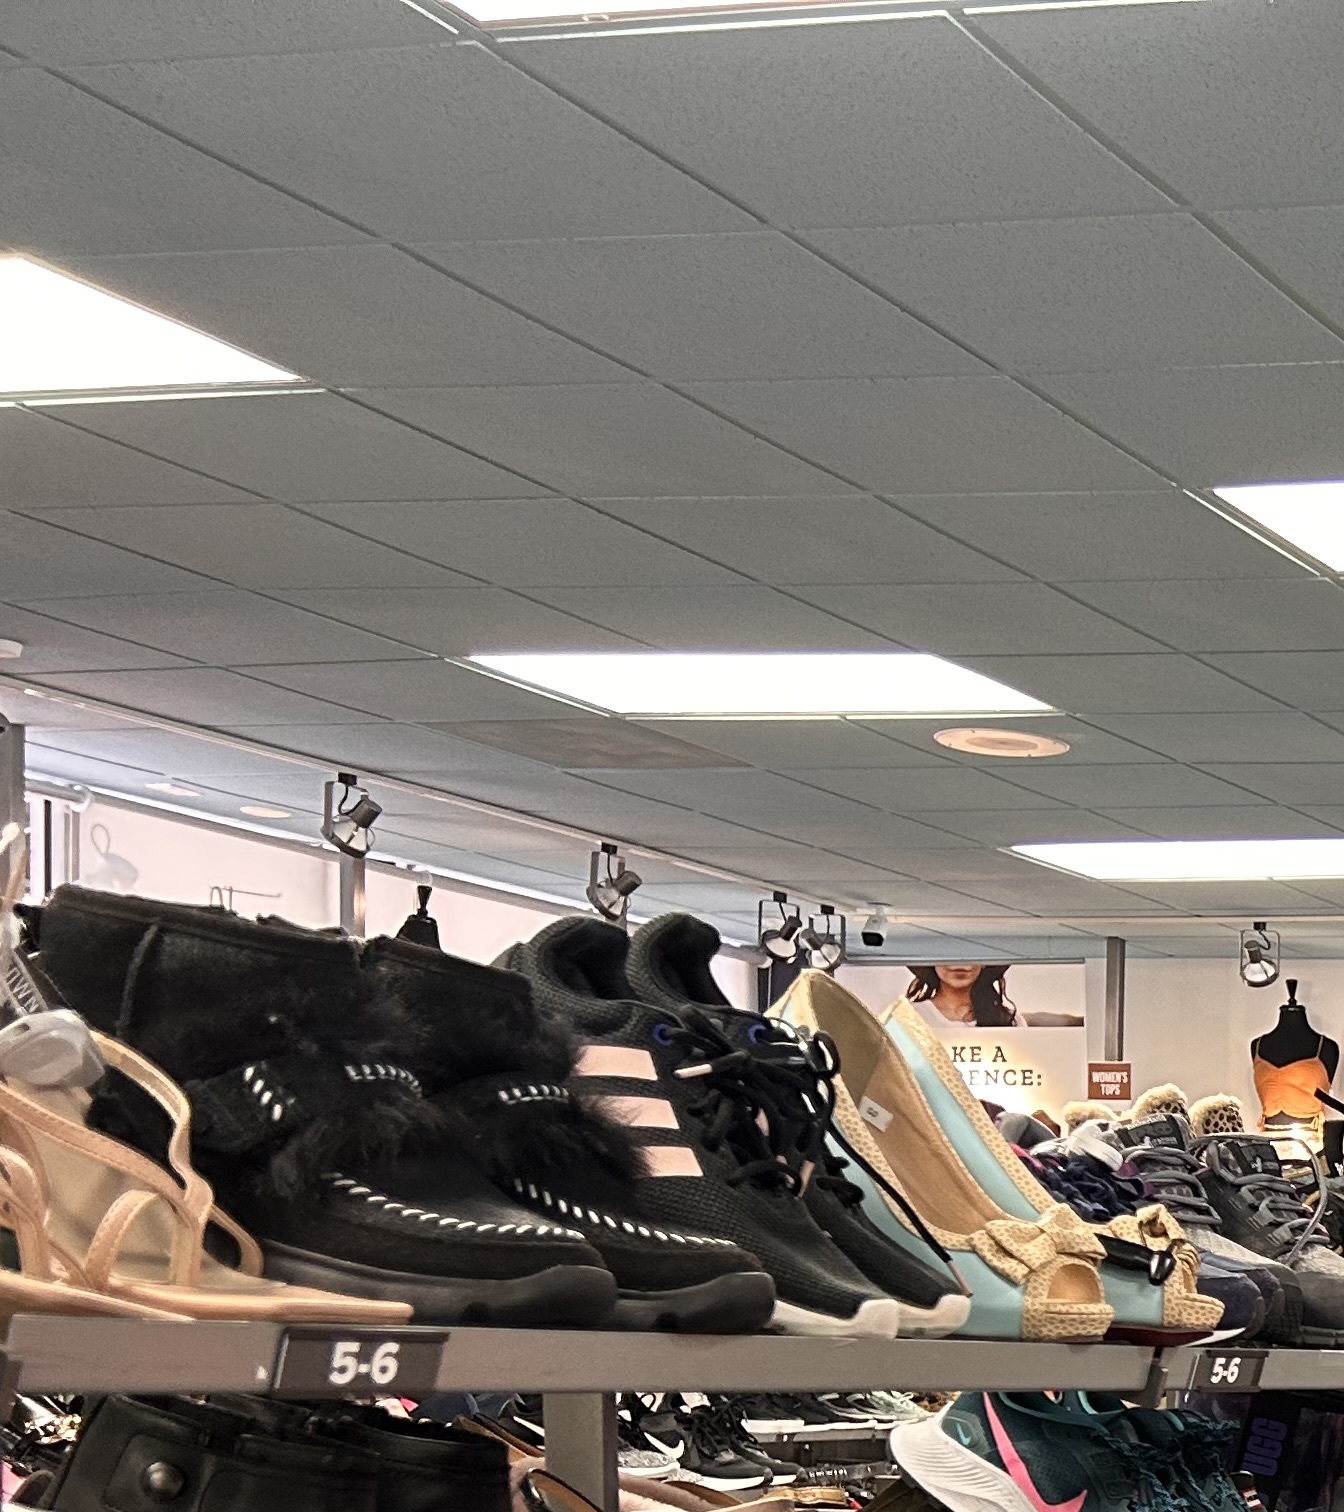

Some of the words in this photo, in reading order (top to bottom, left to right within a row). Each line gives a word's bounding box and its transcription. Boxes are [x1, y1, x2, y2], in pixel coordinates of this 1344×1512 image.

[951, 1046, 982, 1062] KE
[992, 1046, 1007, 1062] A
[968, 1069, 1043, 1086] ENCE:
[1091, 1071, 1128, 1084] WOMEN'S
[1100, 1084, 1121, 1096] TOPS
[328, 1341, 400, 1385] 5-6
[1209, 1356, 1242, 1385] 5-6
[1241, 1417, 1288, 1477] UGG
